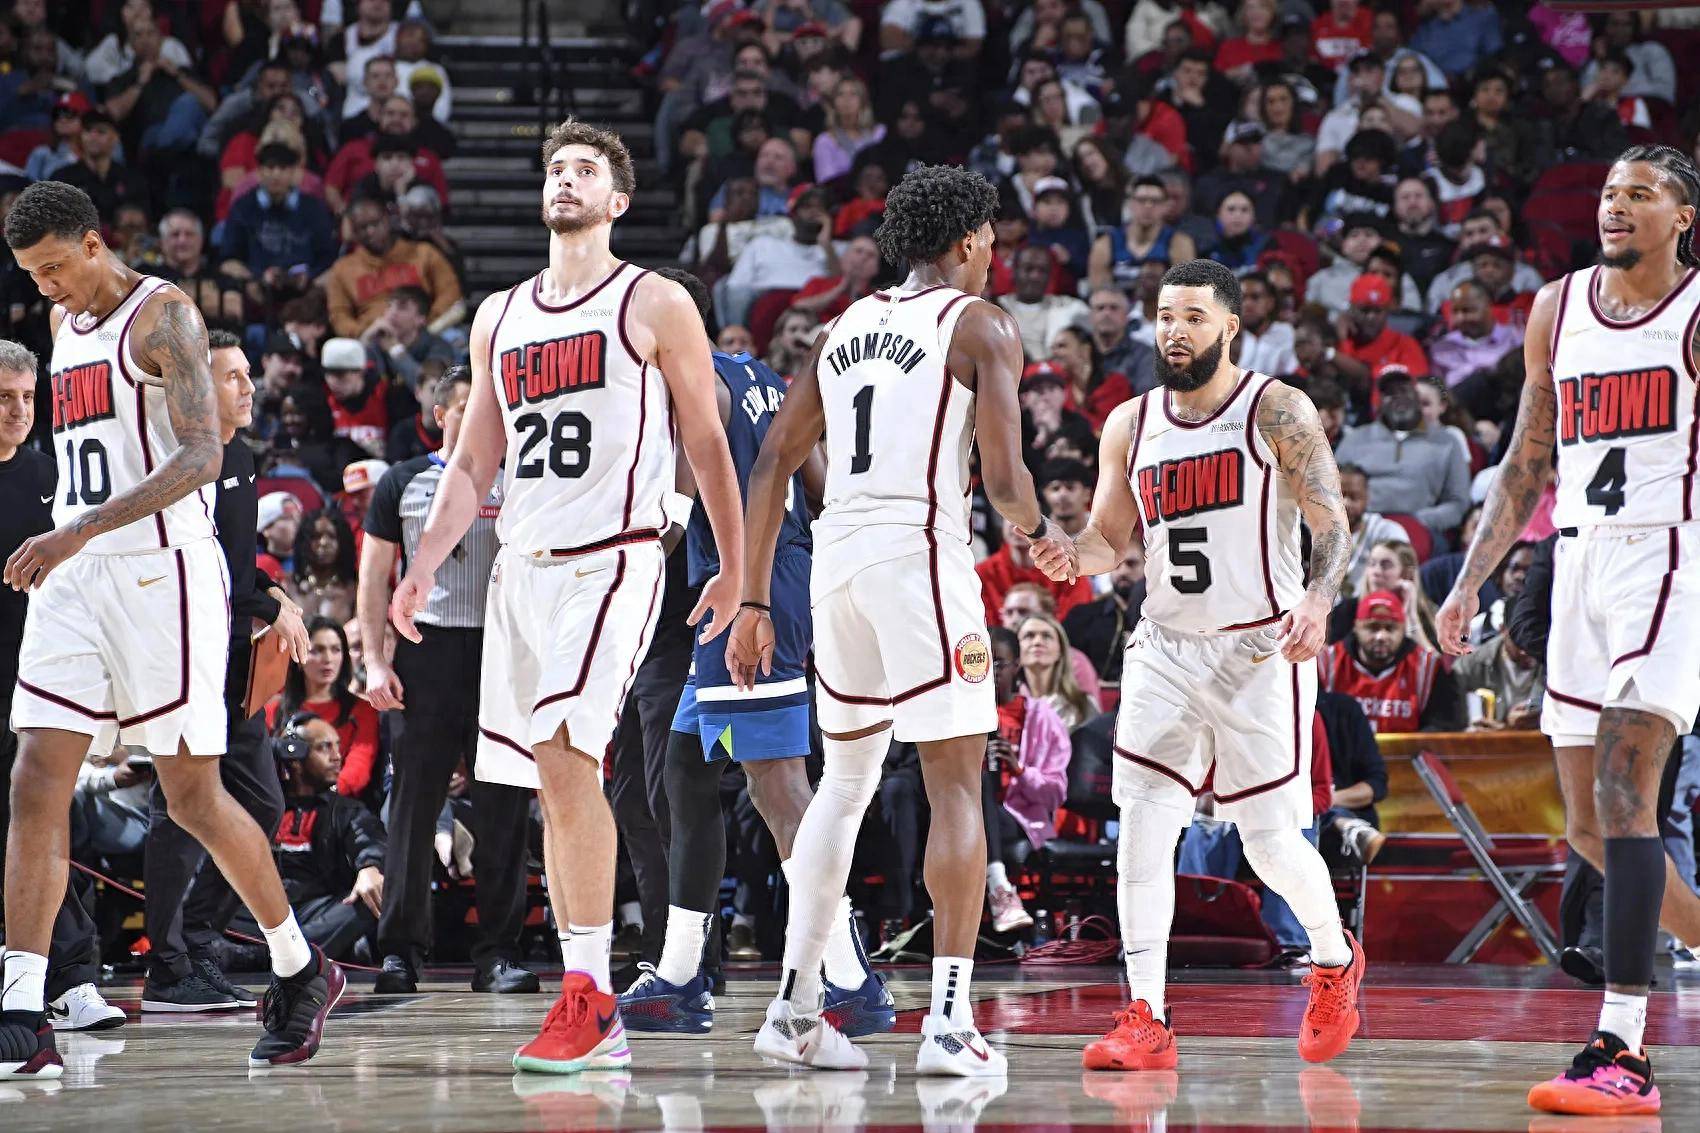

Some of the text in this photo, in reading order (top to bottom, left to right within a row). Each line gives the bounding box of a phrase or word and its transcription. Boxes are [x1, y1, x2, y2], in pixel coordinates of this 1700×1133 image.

[827, 333, 926, 376] THOMPSON
[742, 385, 785, 425] EDWAR
[850, 385, 874, 475] 1
[66, 439, 112, 505] 10
[514, 411, 592, 478] 28
[1585, 447, 1627, 516] 4
[1168, 527, 1212, 594] 5
